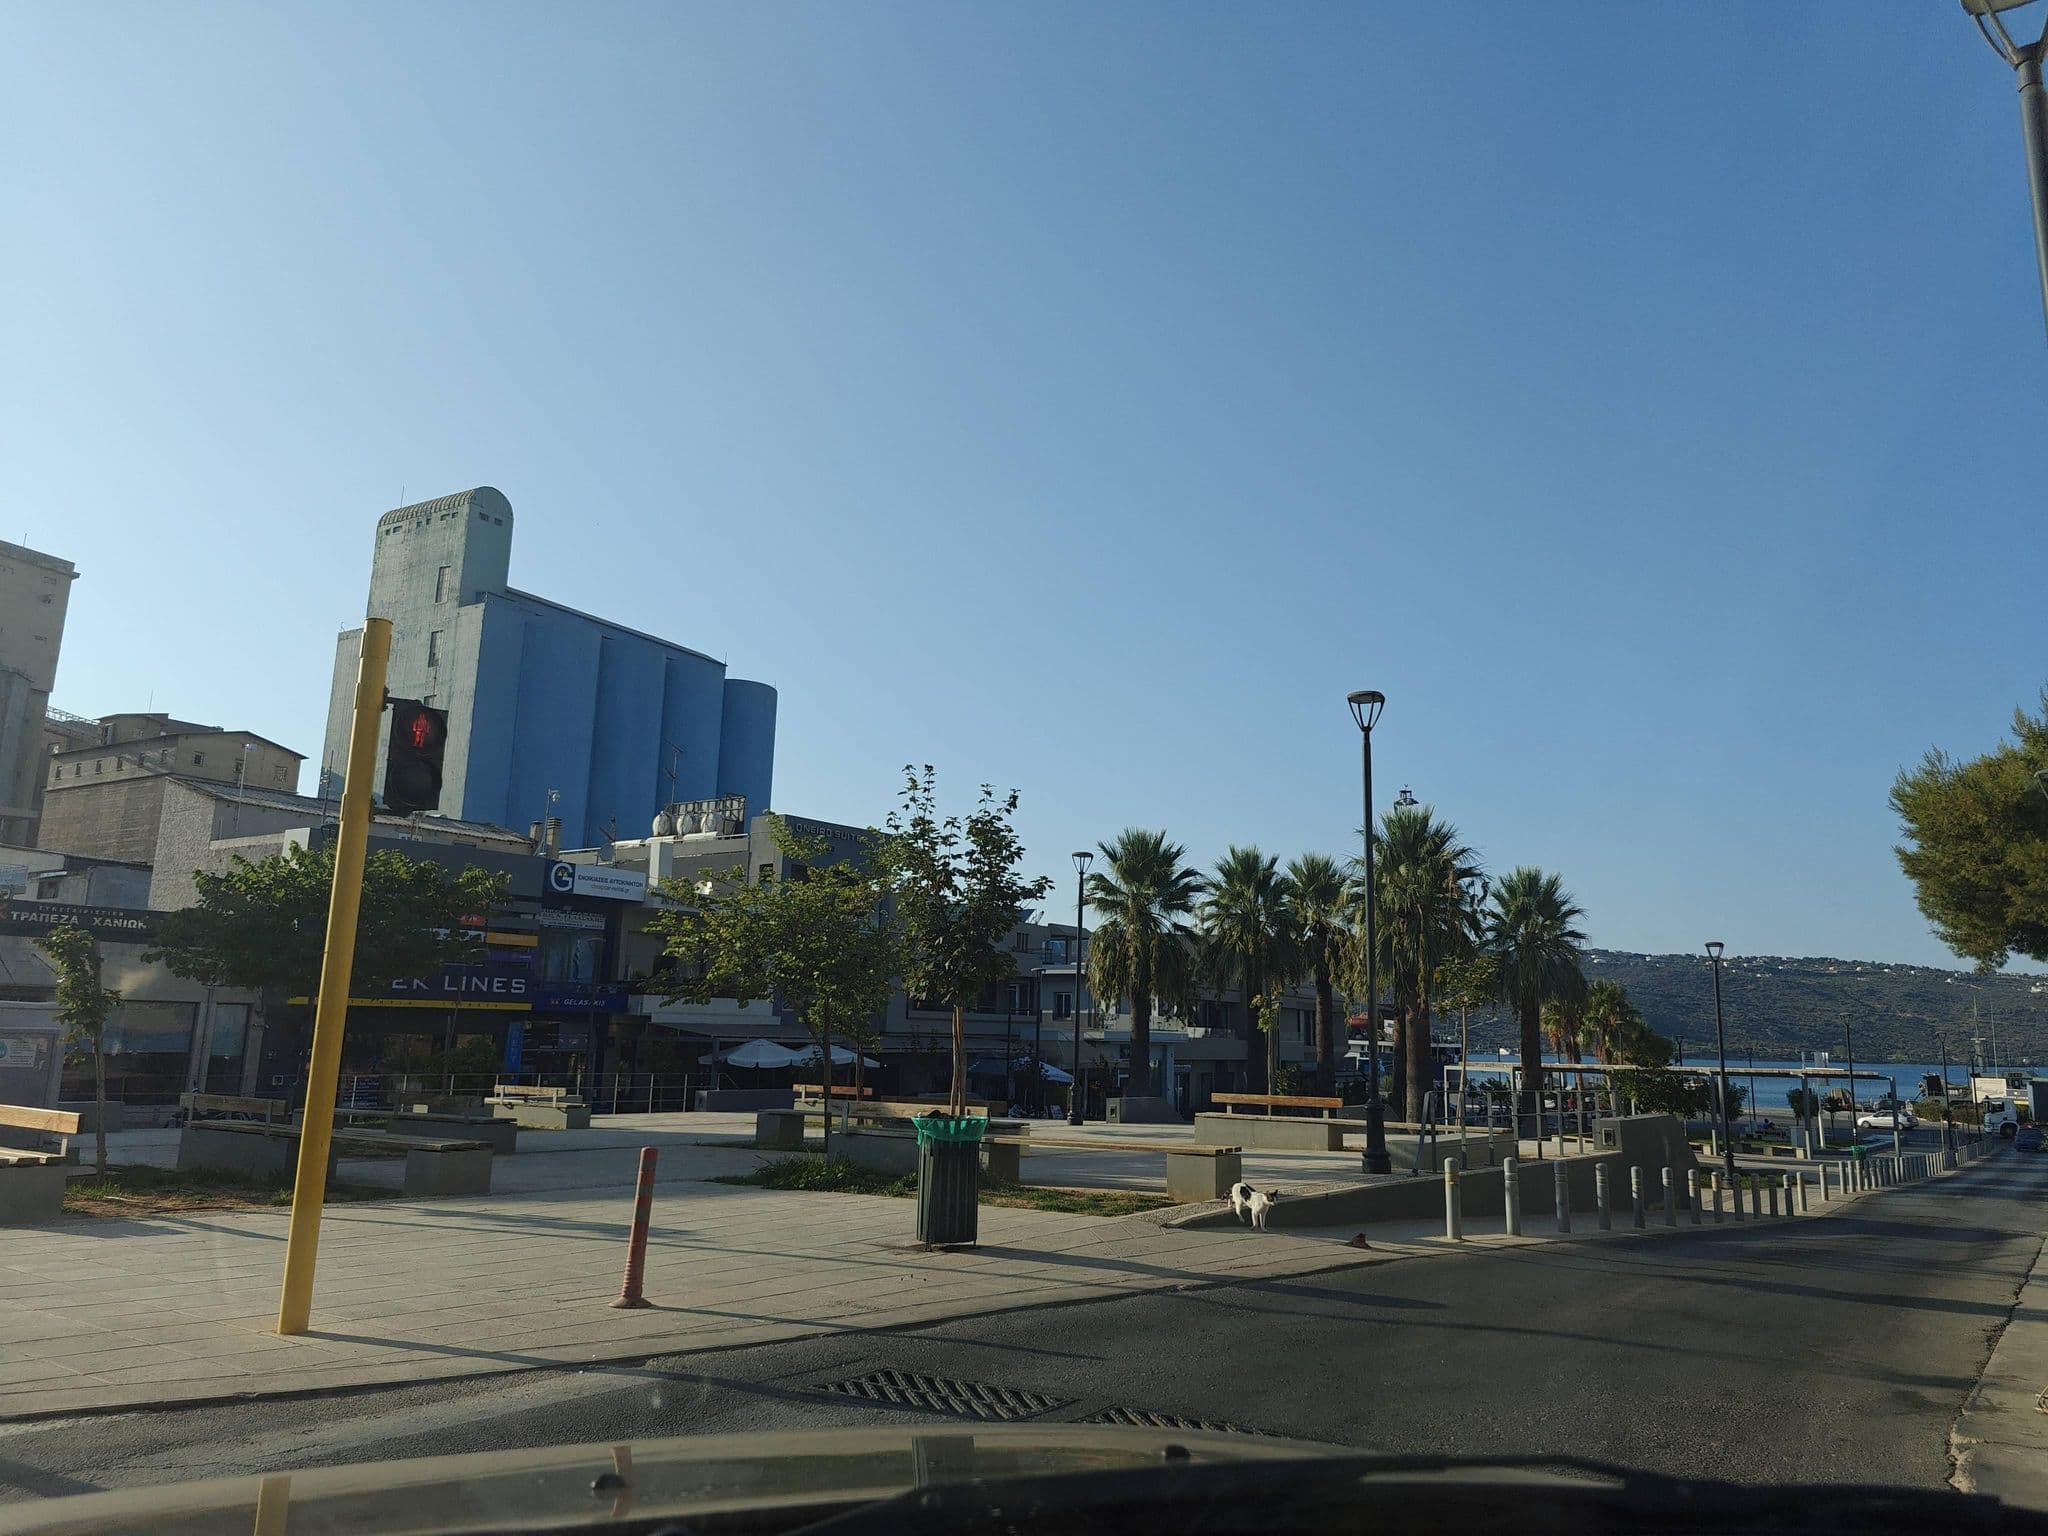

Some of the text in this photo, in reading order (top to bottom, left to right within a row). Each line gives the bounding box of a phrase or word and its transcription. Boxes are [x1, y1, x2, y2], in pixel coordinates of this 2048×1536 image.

[796, 823, 832, 837] ONEIRO
[11, 911, 79, 925] ΤΡΑΠΕΖΑ
[444, 975, 526, 994] LINES
